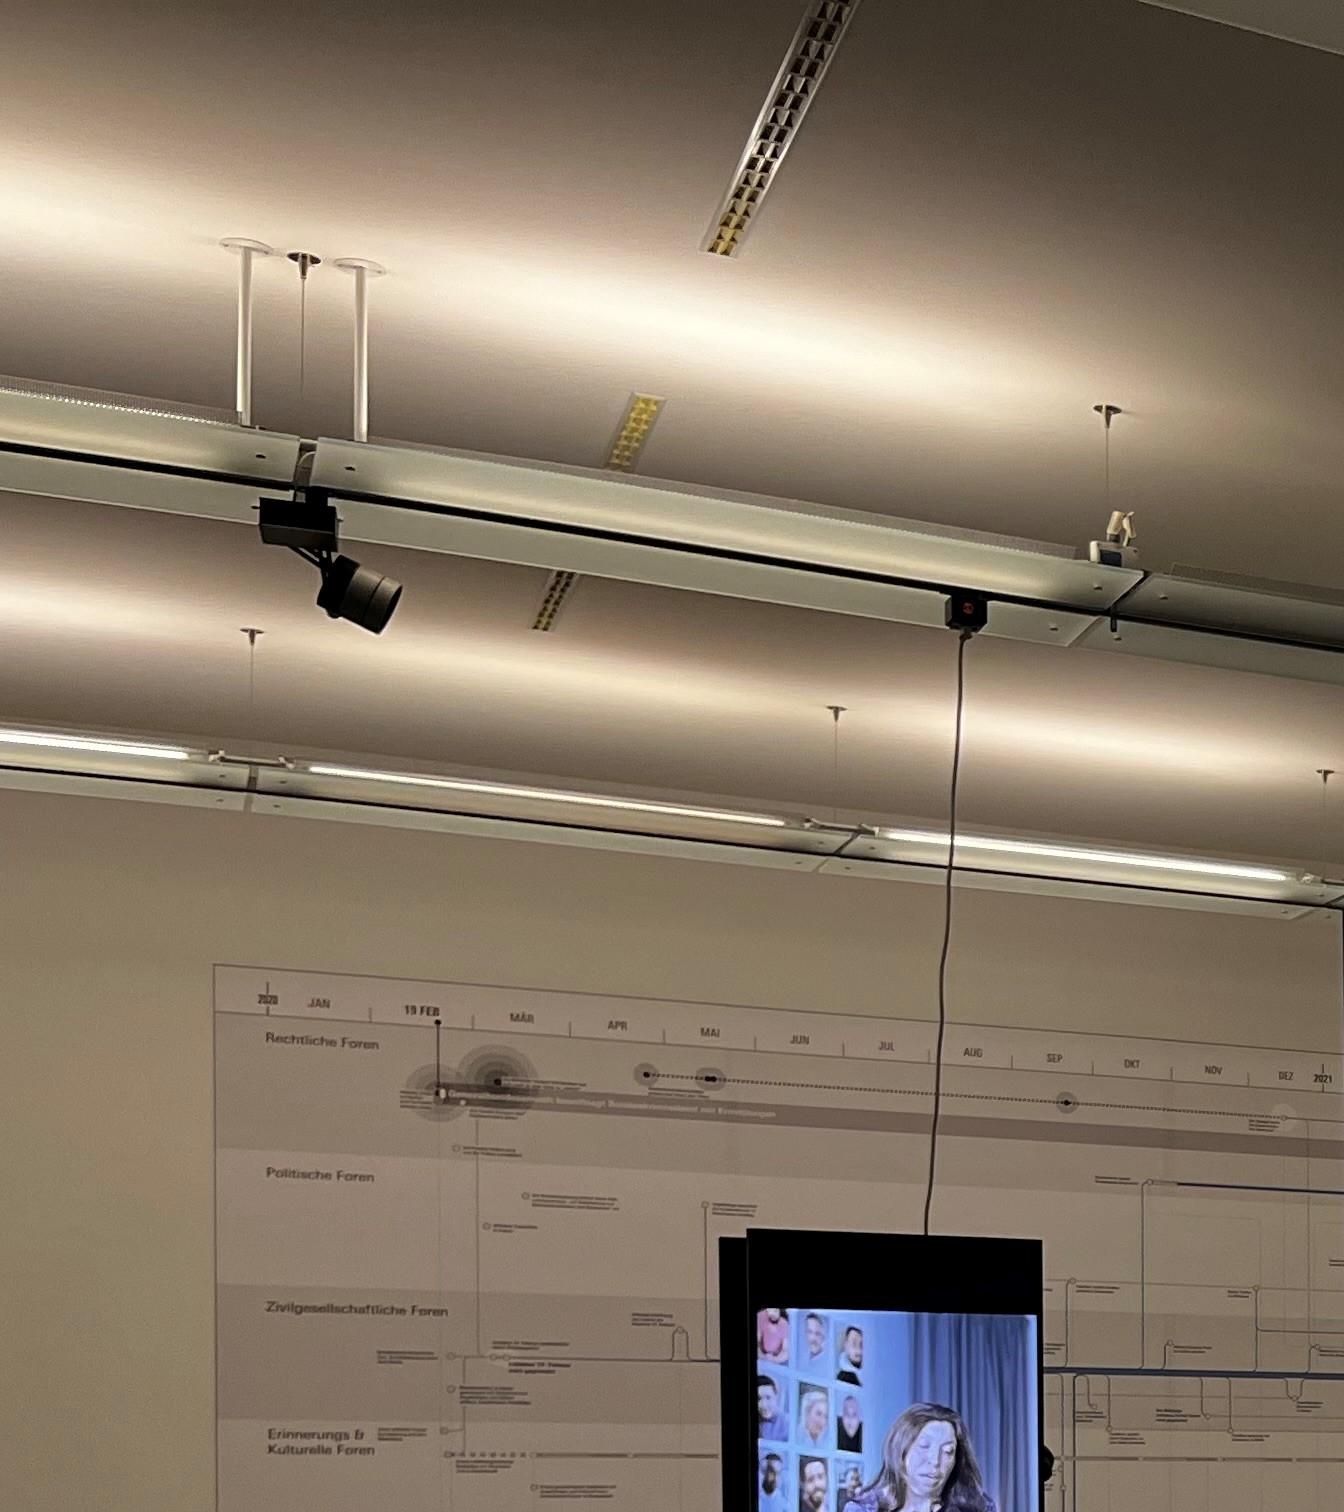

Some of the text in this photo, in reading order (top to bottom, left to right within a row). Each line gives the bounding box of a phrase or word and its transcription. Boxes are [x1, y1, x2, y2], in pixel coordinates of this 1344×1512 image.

[265, 1031, 380, 1050] Rechtliche Foren
[307, 997, 330, 1009] JAN
[420, 1005, 440, 1017] FEB
[607, 1020, 628, 1031] APR
[700, 1027, 721, 1038] MAI
[789, 1035, 810, 1045] JUN
[878, 1041, 895, 1051] JUL
[963, 1047, 983, 1058] AUG
[1046, 1053, 1063, 1064] SEP
[1205, 1065, 1223, 1075] NOV
[1278, 1071, 1294, 1081] DEZ
[1313, 1074, 1333, 1084] 2021
[266, 1167, 375, 1183] Politische Foren
[265, 1301, 449, 1317] Zivilgesellschaftliche Foren
[268, 1428, 350, 1442] Erinnerungs
[267, 1443, 376, 1456] Kulturelle Foren
